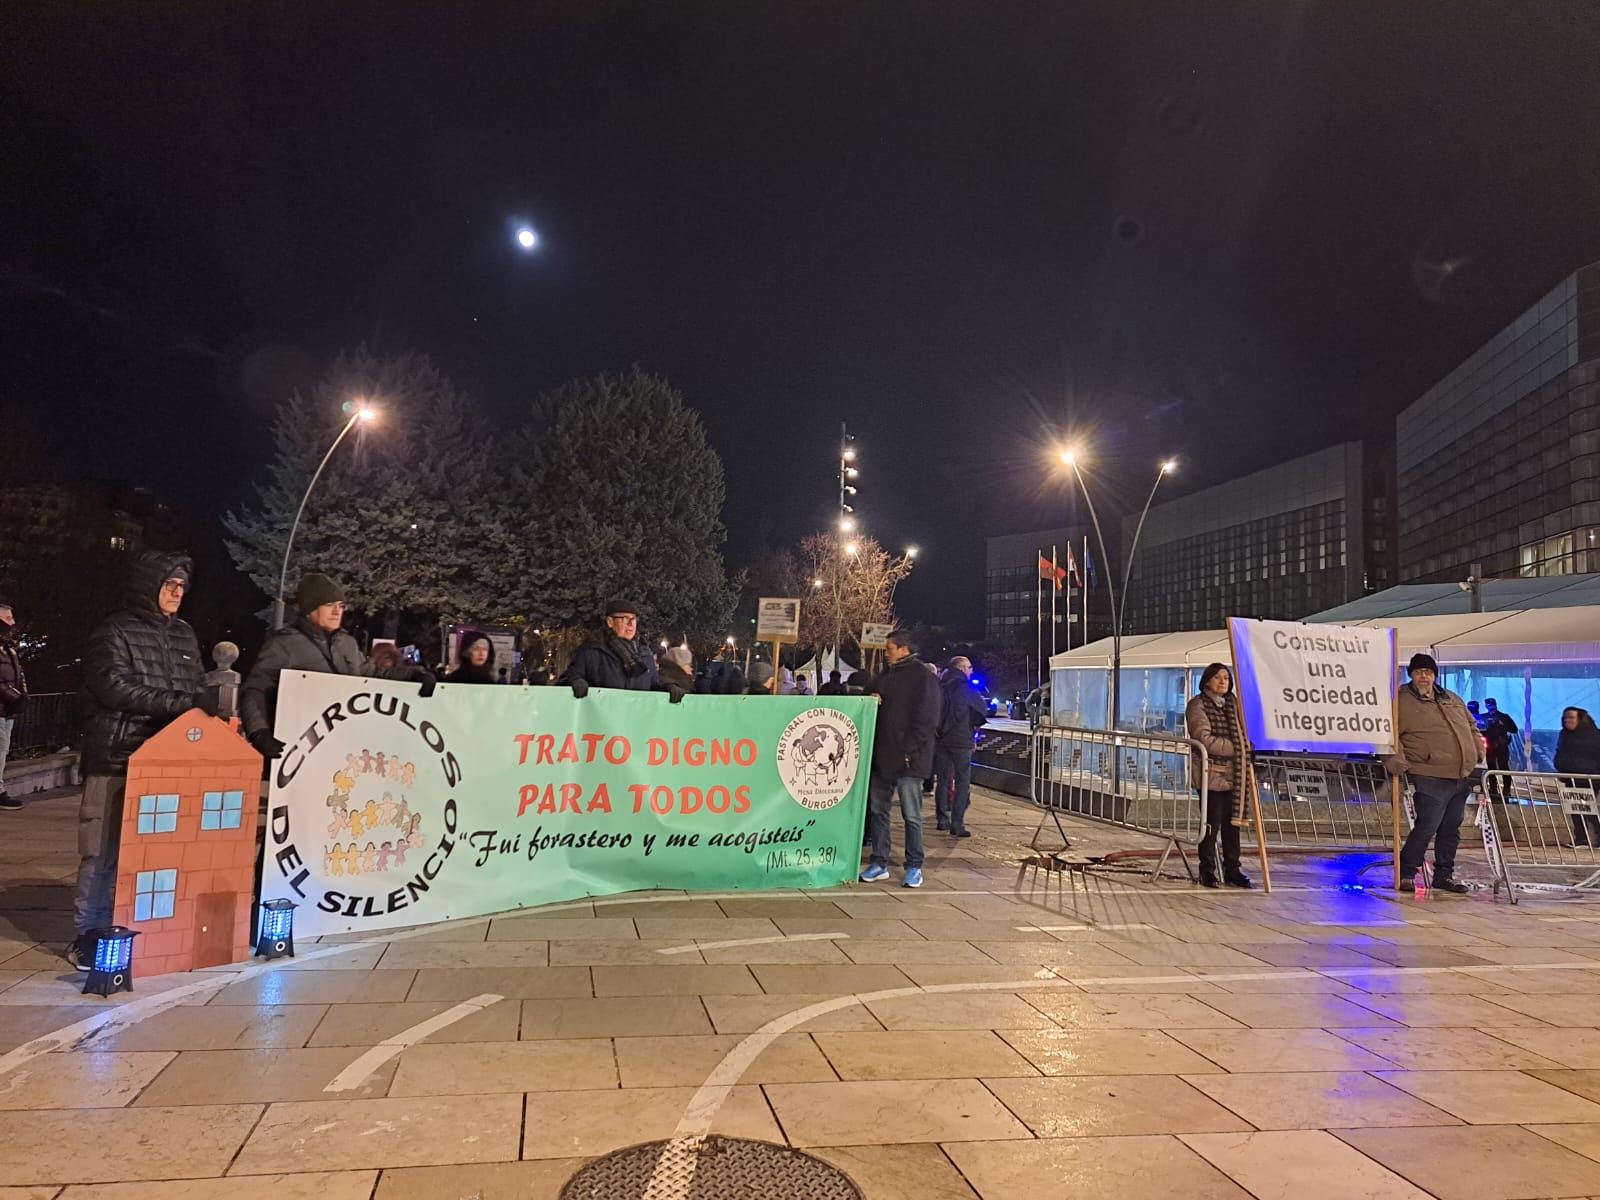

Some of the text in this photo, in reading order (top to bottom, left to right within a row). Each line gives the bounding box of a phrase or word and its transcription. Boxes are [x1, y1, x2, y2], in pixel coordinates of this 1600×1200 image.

[1273, 630, 1370, 654] Construir
[1308, 661, 1346, 679] una
[1283, 684, 1378, 706] sociedad
[777, 709, 860, 761] PASTORAL CON INMIGRANTES
[1274, 709, 1391, 736] integradora
[276, 692, 462, 789] CIRCULOS
[514, 733, 757, 766] TRATO DIGNO
[516, 783, 751, 817] PARA TODOS
[801, 796, 839, 809] BURGOS
[271, 798, 458, 918] DEL SILENCIO
[527, 826, 632, 862] forastero
[642, 832, 657, 856] y
[666, 832, 700, 848] me
[766, 850, 792, 874] (Mt.
[818, 845, 837, 867] 38)
